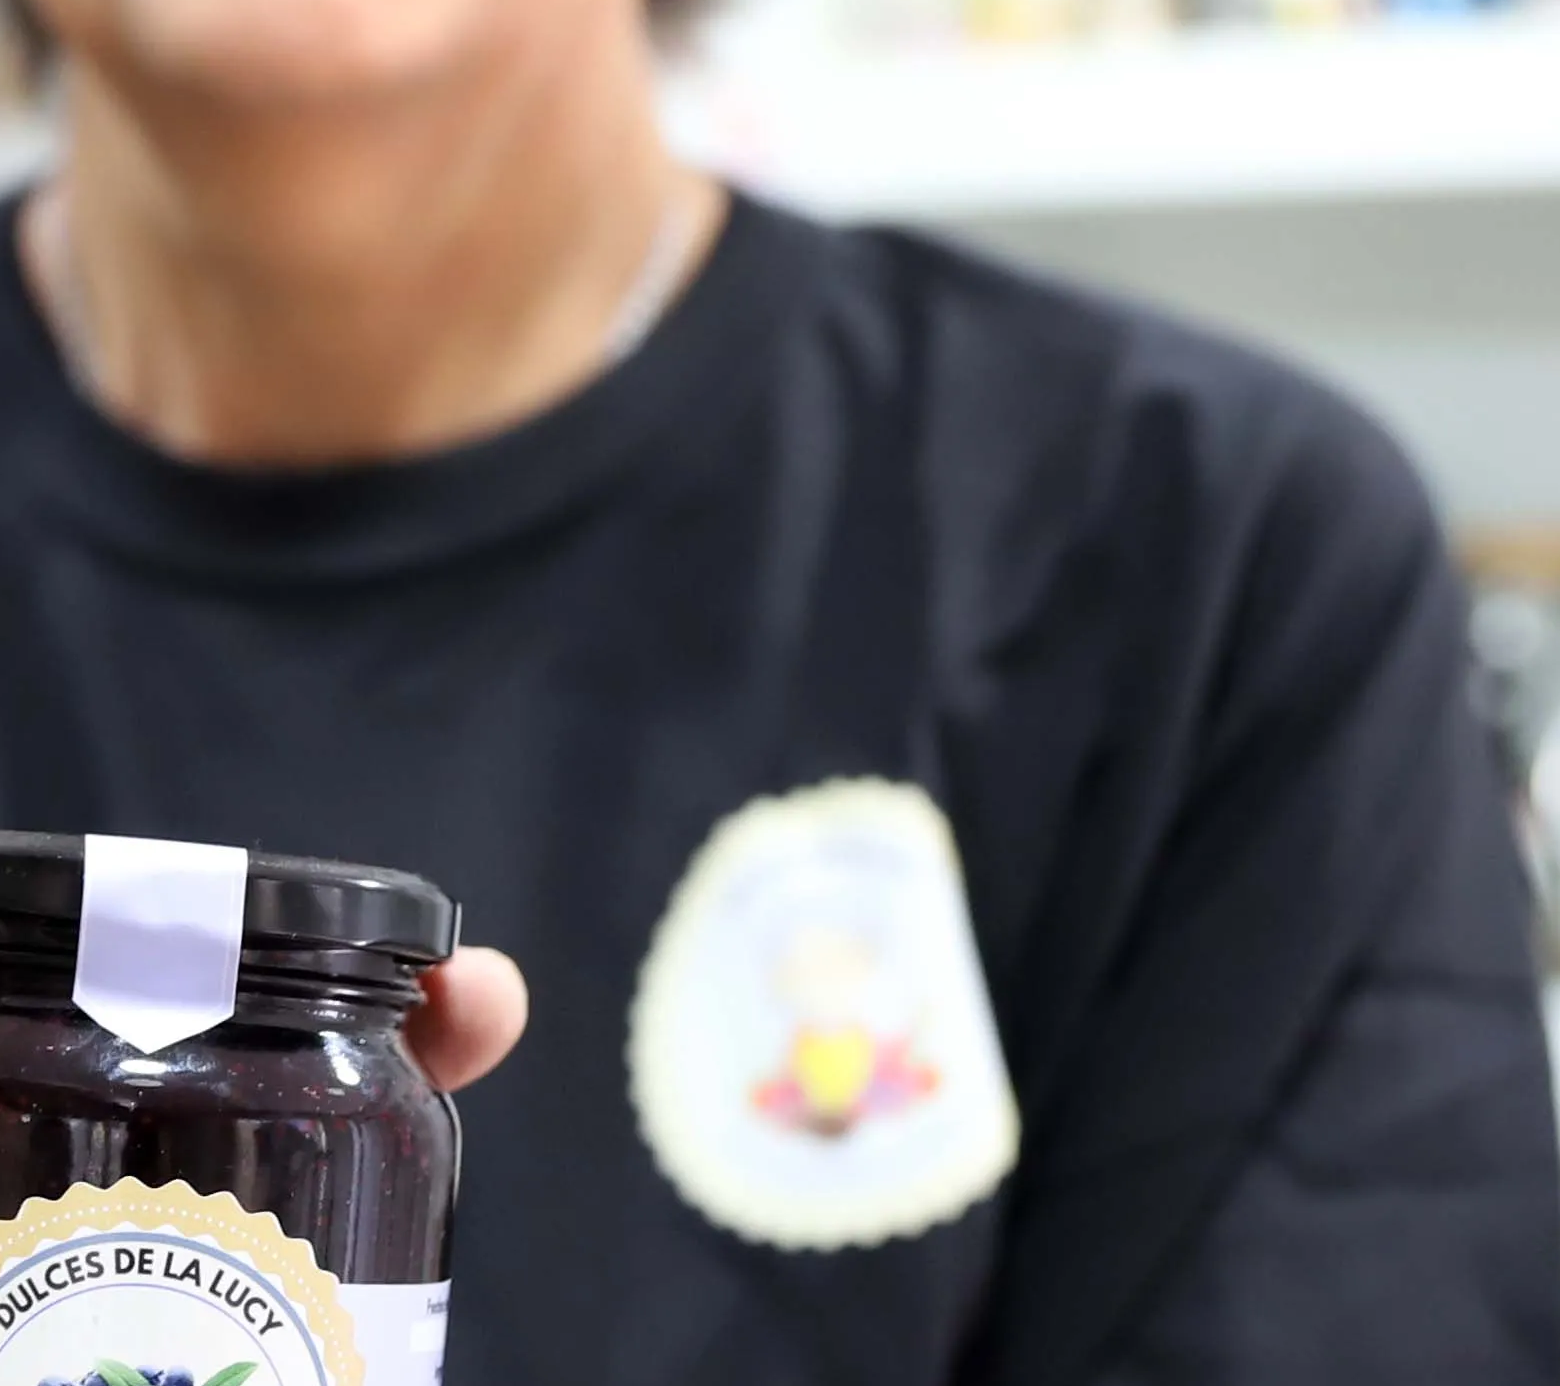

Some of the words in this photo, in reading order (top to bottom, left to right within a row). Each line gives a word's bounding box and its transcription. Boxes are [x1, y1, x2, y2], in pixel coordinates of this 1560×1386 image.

[114, 1248, 154, 1275] DE
[163, 1251, 202, 1287] LA
[208, 1269, 284, 1336] LUCY
